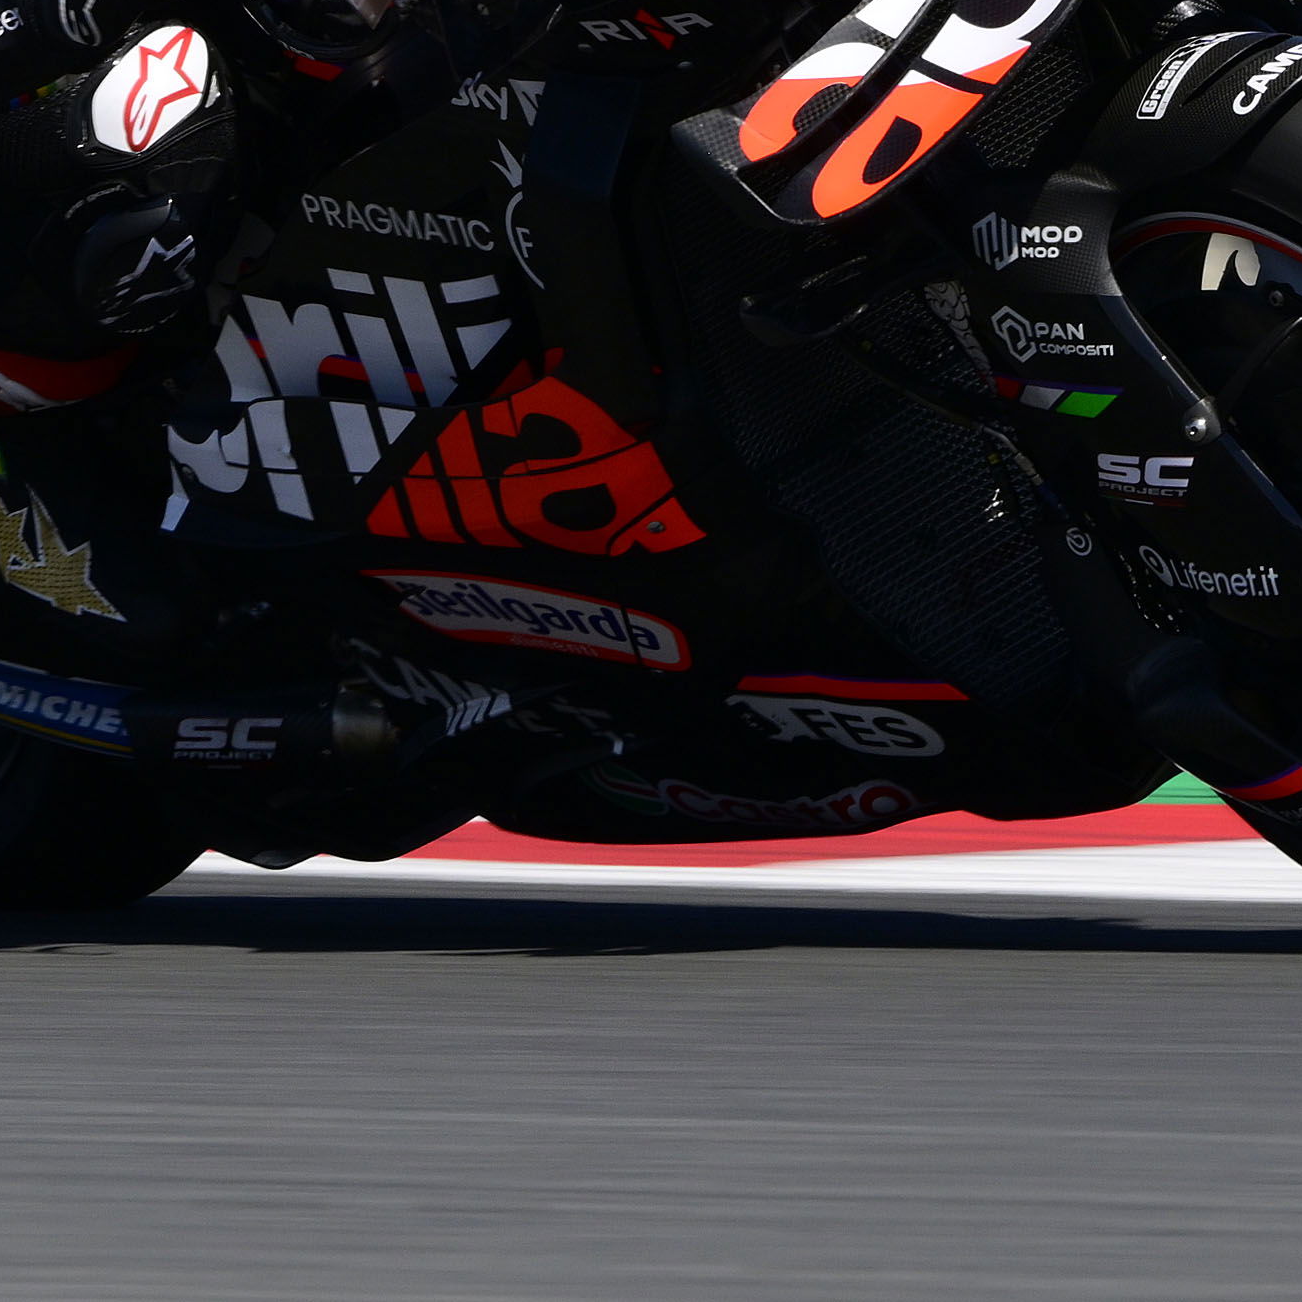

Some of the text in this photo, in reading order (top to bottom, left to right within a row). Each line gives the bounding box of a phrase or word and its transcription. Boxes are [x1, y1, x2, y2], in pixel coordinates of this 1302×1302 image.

[451, 71, 510, 121] sky
[300, 194, 495, 254] PRAGMATIC
[1020, 225, 1083, 244] MOD
[1020, 245, 1060, 259] MOD
[1033, 322, 1085, 341] PAN
[1038, 342, 1114, 358] COMPOSITI
[1098, 453, 1195, 488] SC
[1098, 481, 1187, 497] PROJECT
[1169, 559, 1280, 597] Lifenet.it
[173, 717, 285, 749] SC
[658, 778, 920, 826] Castro
